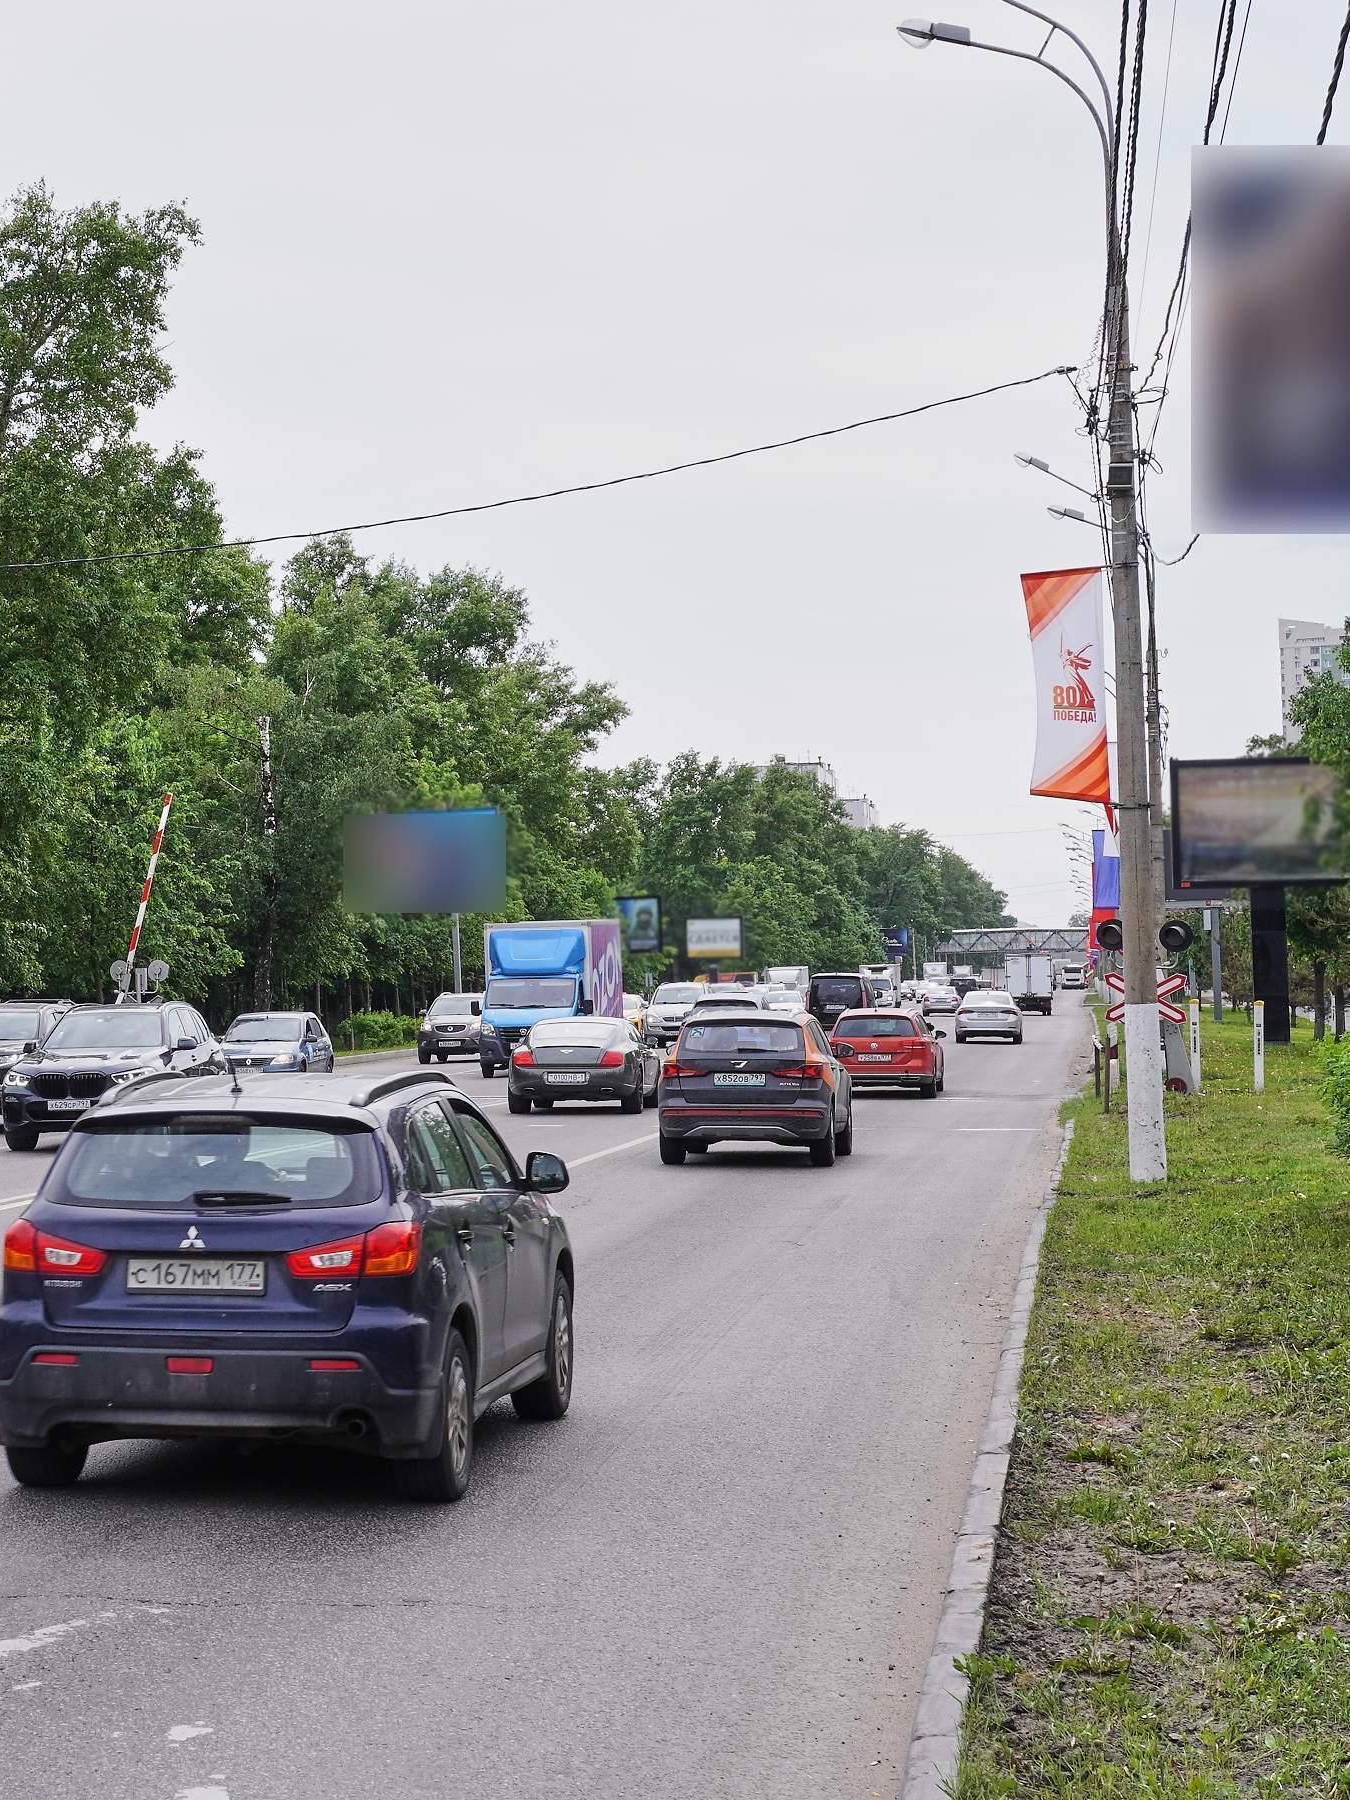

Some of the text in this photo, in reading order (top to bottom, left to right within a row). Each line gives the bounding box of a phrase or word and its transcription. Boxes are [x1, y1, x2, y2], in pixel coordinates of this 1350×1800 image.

[1053, 685, 1078, 706] 80
[1053, 710, 1097, 724] ПОБЕДА!
[312, 1283, 353, 1292] ASX
